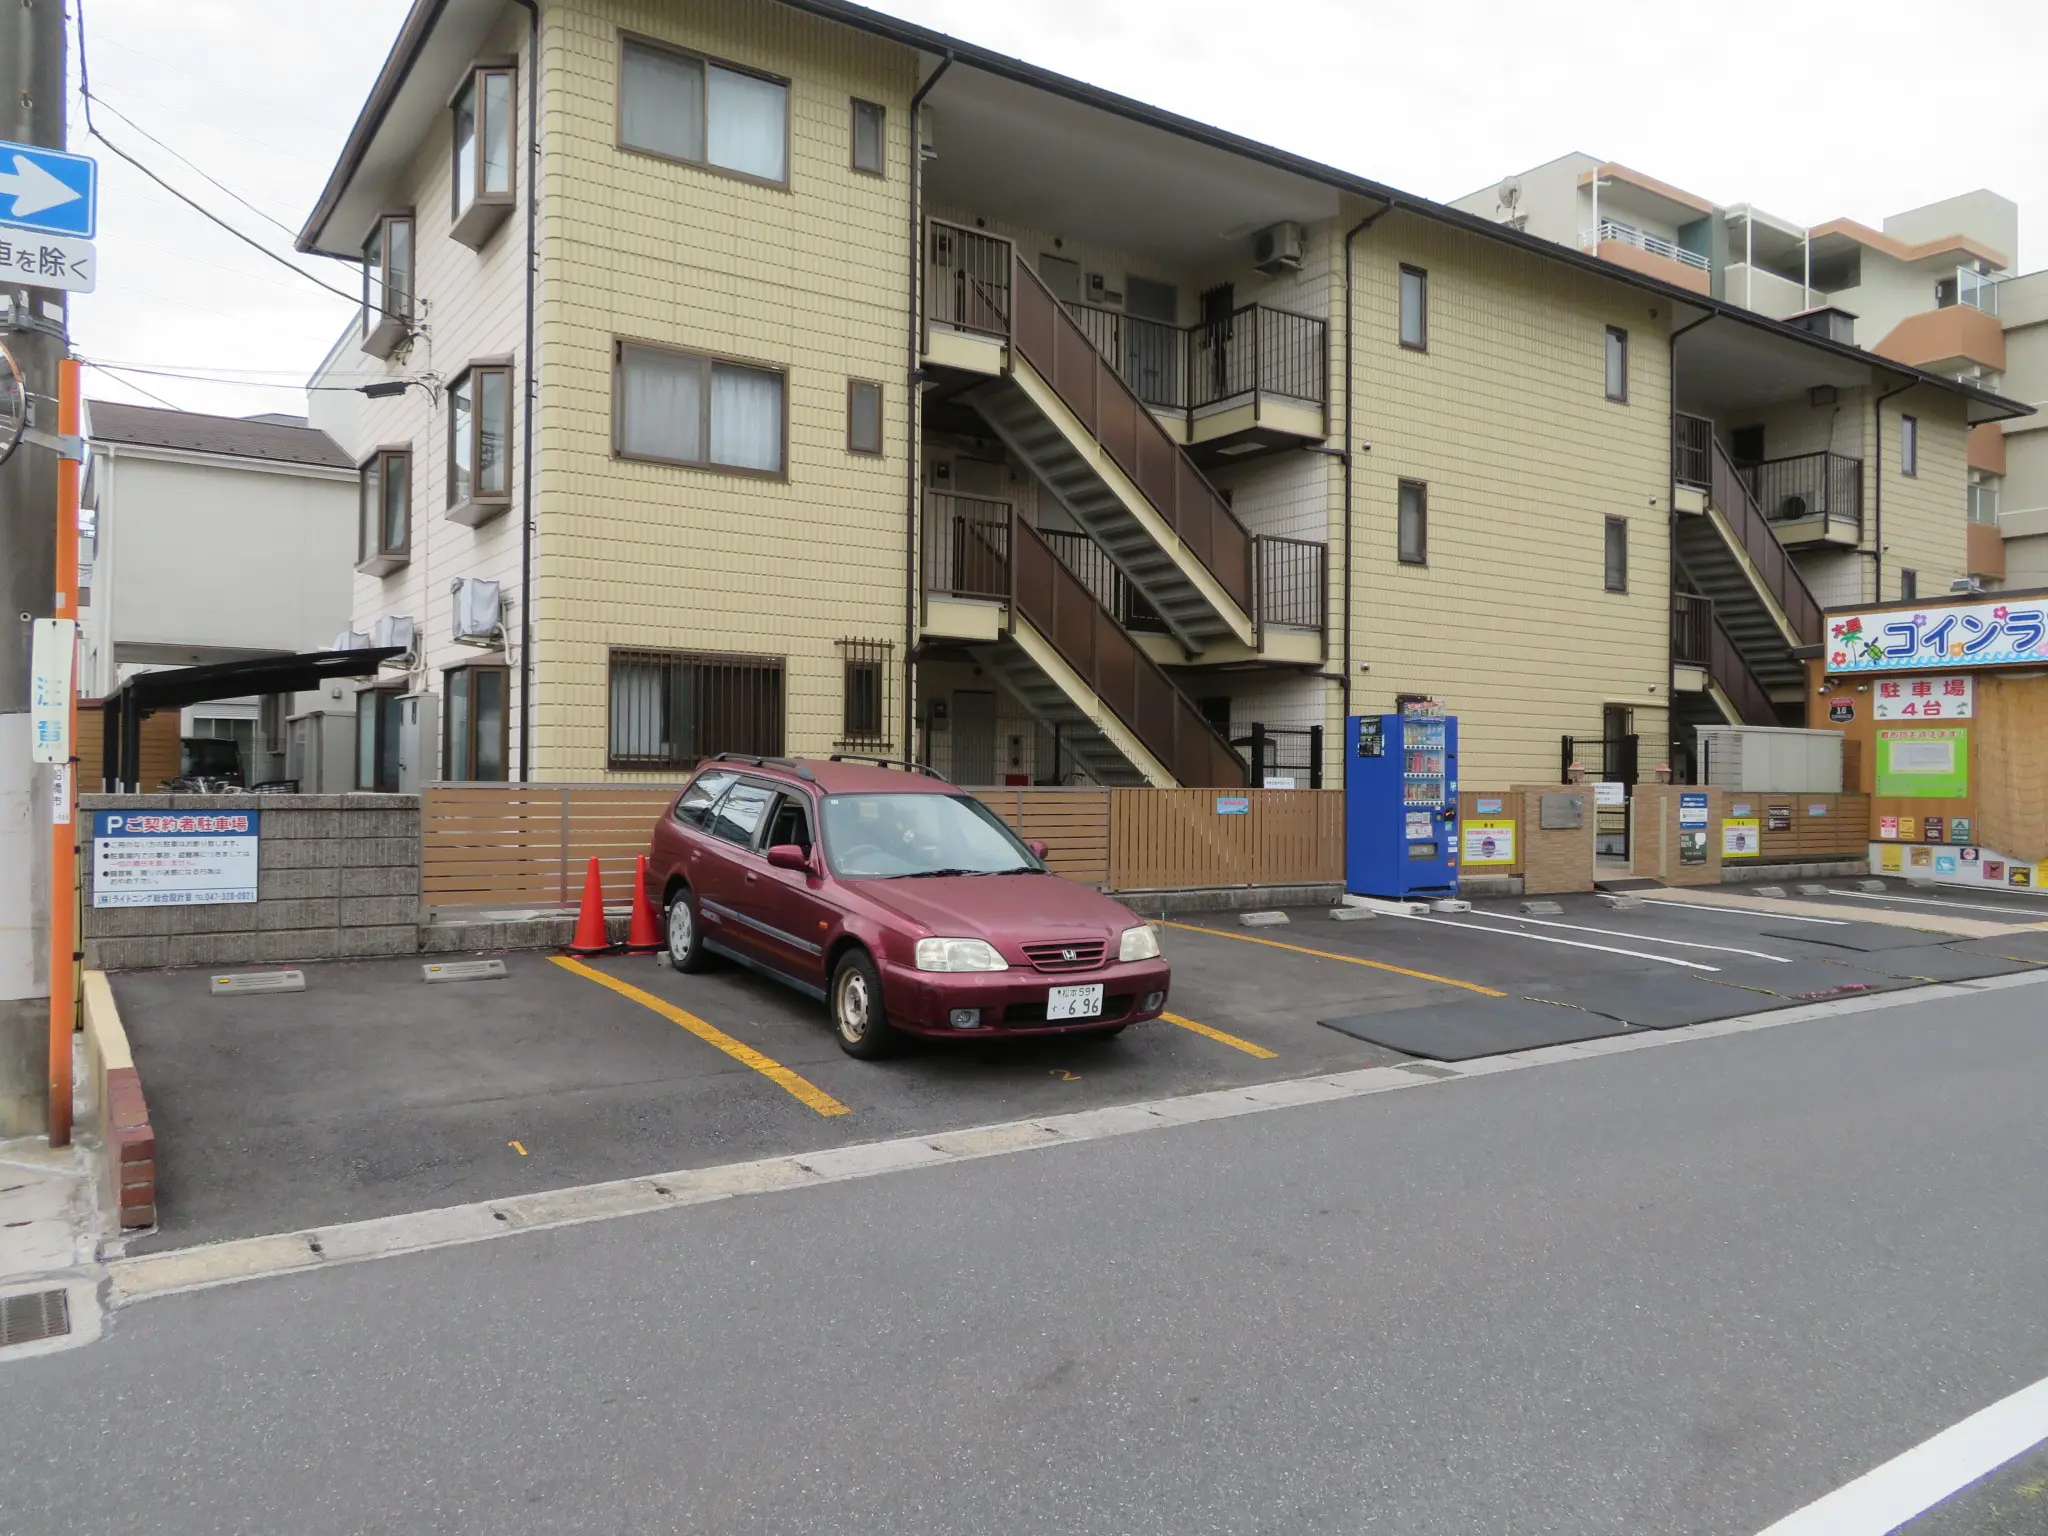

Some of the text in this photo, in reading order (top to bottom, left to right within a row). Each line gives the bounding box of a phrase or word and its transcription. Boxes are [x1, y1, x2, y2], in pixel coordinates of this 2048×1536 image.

[1880, 679, 1966, 698] 駐車場
[1901, 700, 1942, 716] 4台
[107, 815, 249, 834] P ご契約者駐車場
